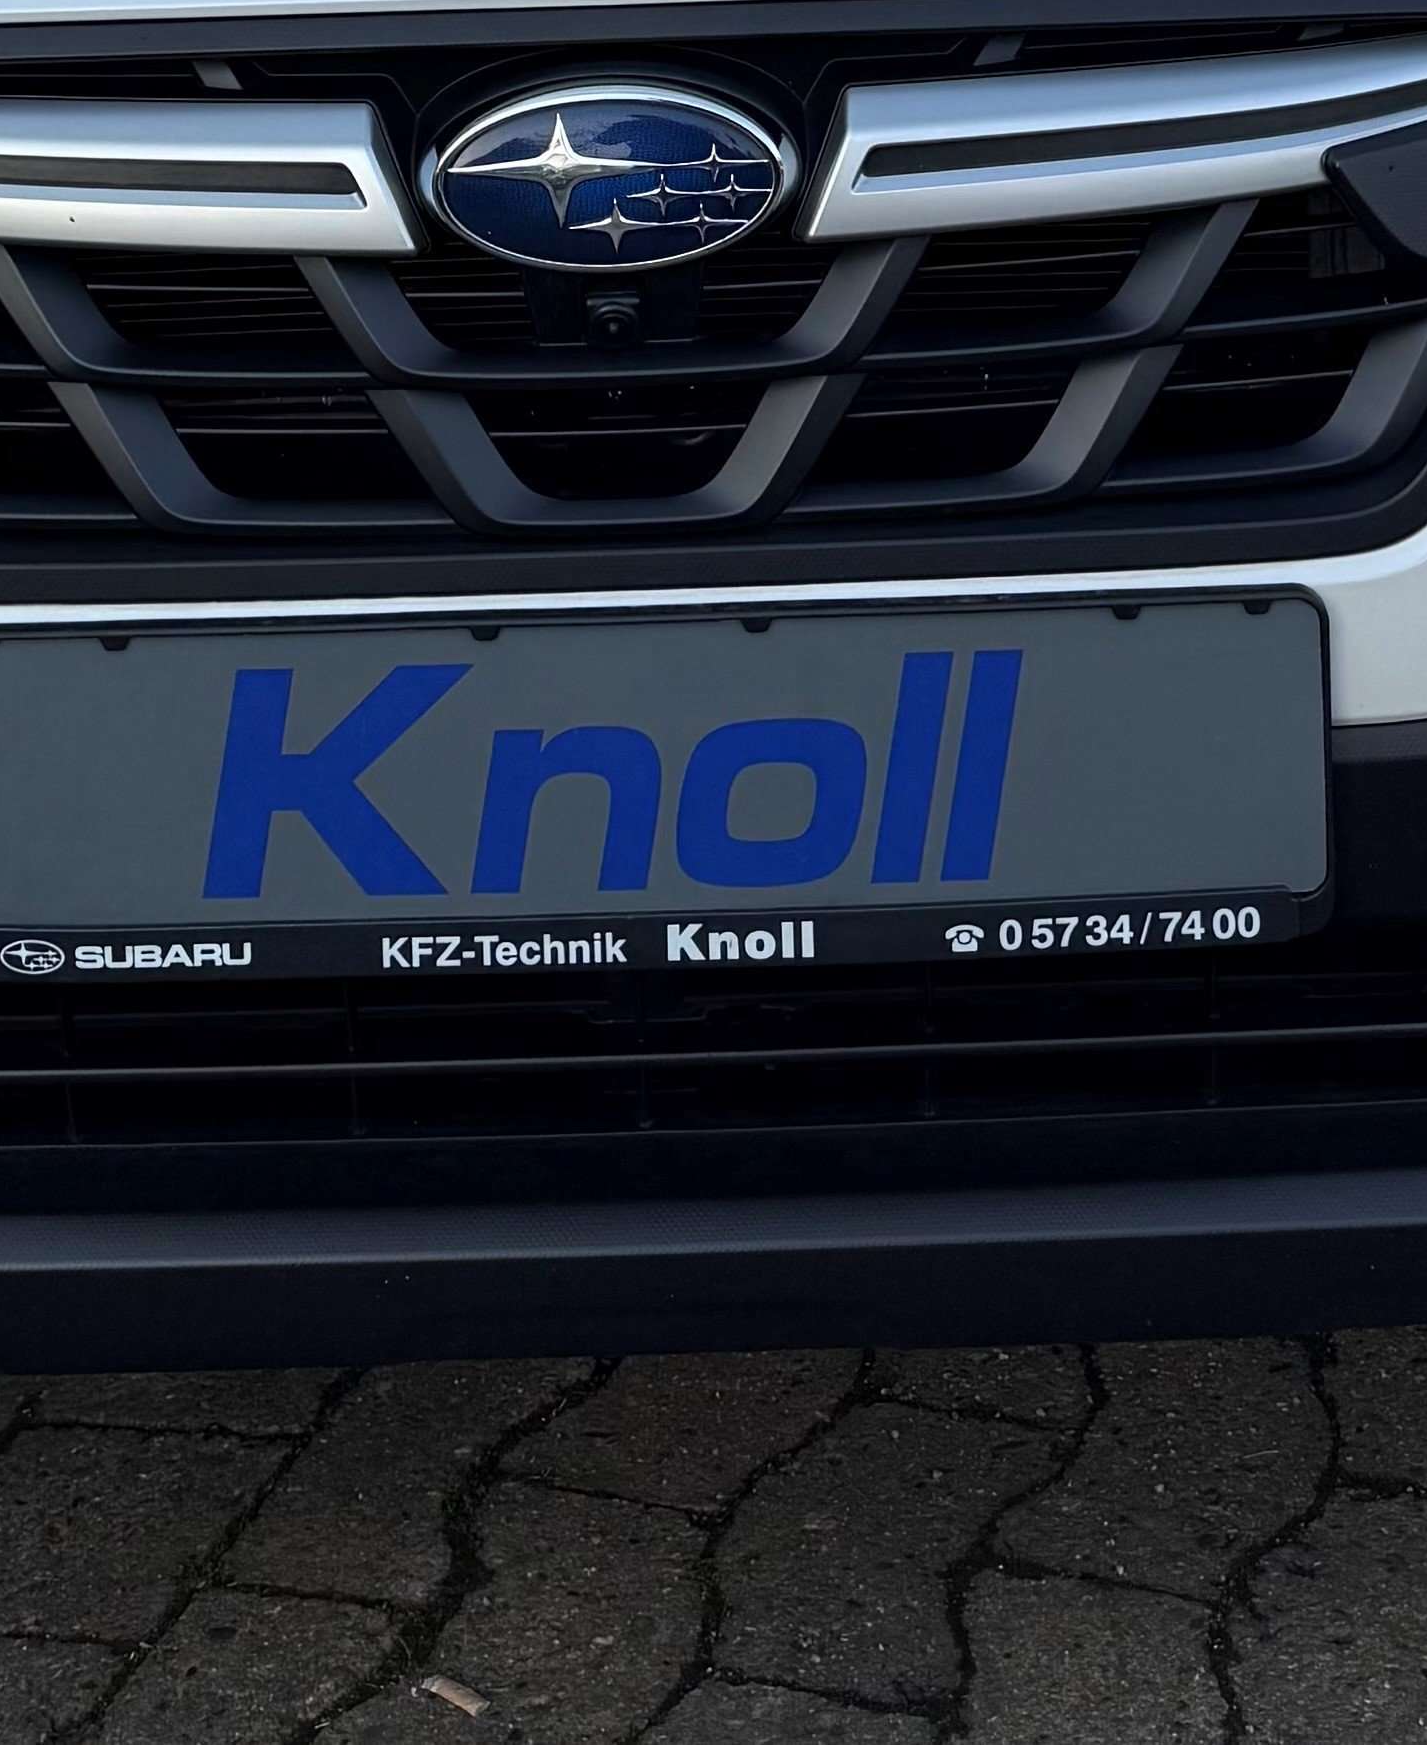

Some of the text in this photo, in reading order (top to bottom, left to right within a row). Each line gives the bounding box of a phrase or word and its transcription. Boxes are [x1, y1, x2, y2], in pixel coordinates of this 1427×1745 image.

[201, 648, 1025, 900] Knoll
[74, 941, 253, 970] SUBARU
[381, 931, 628, 969] KFZ-Technik
[666, 920, 816, 962] Knoll
